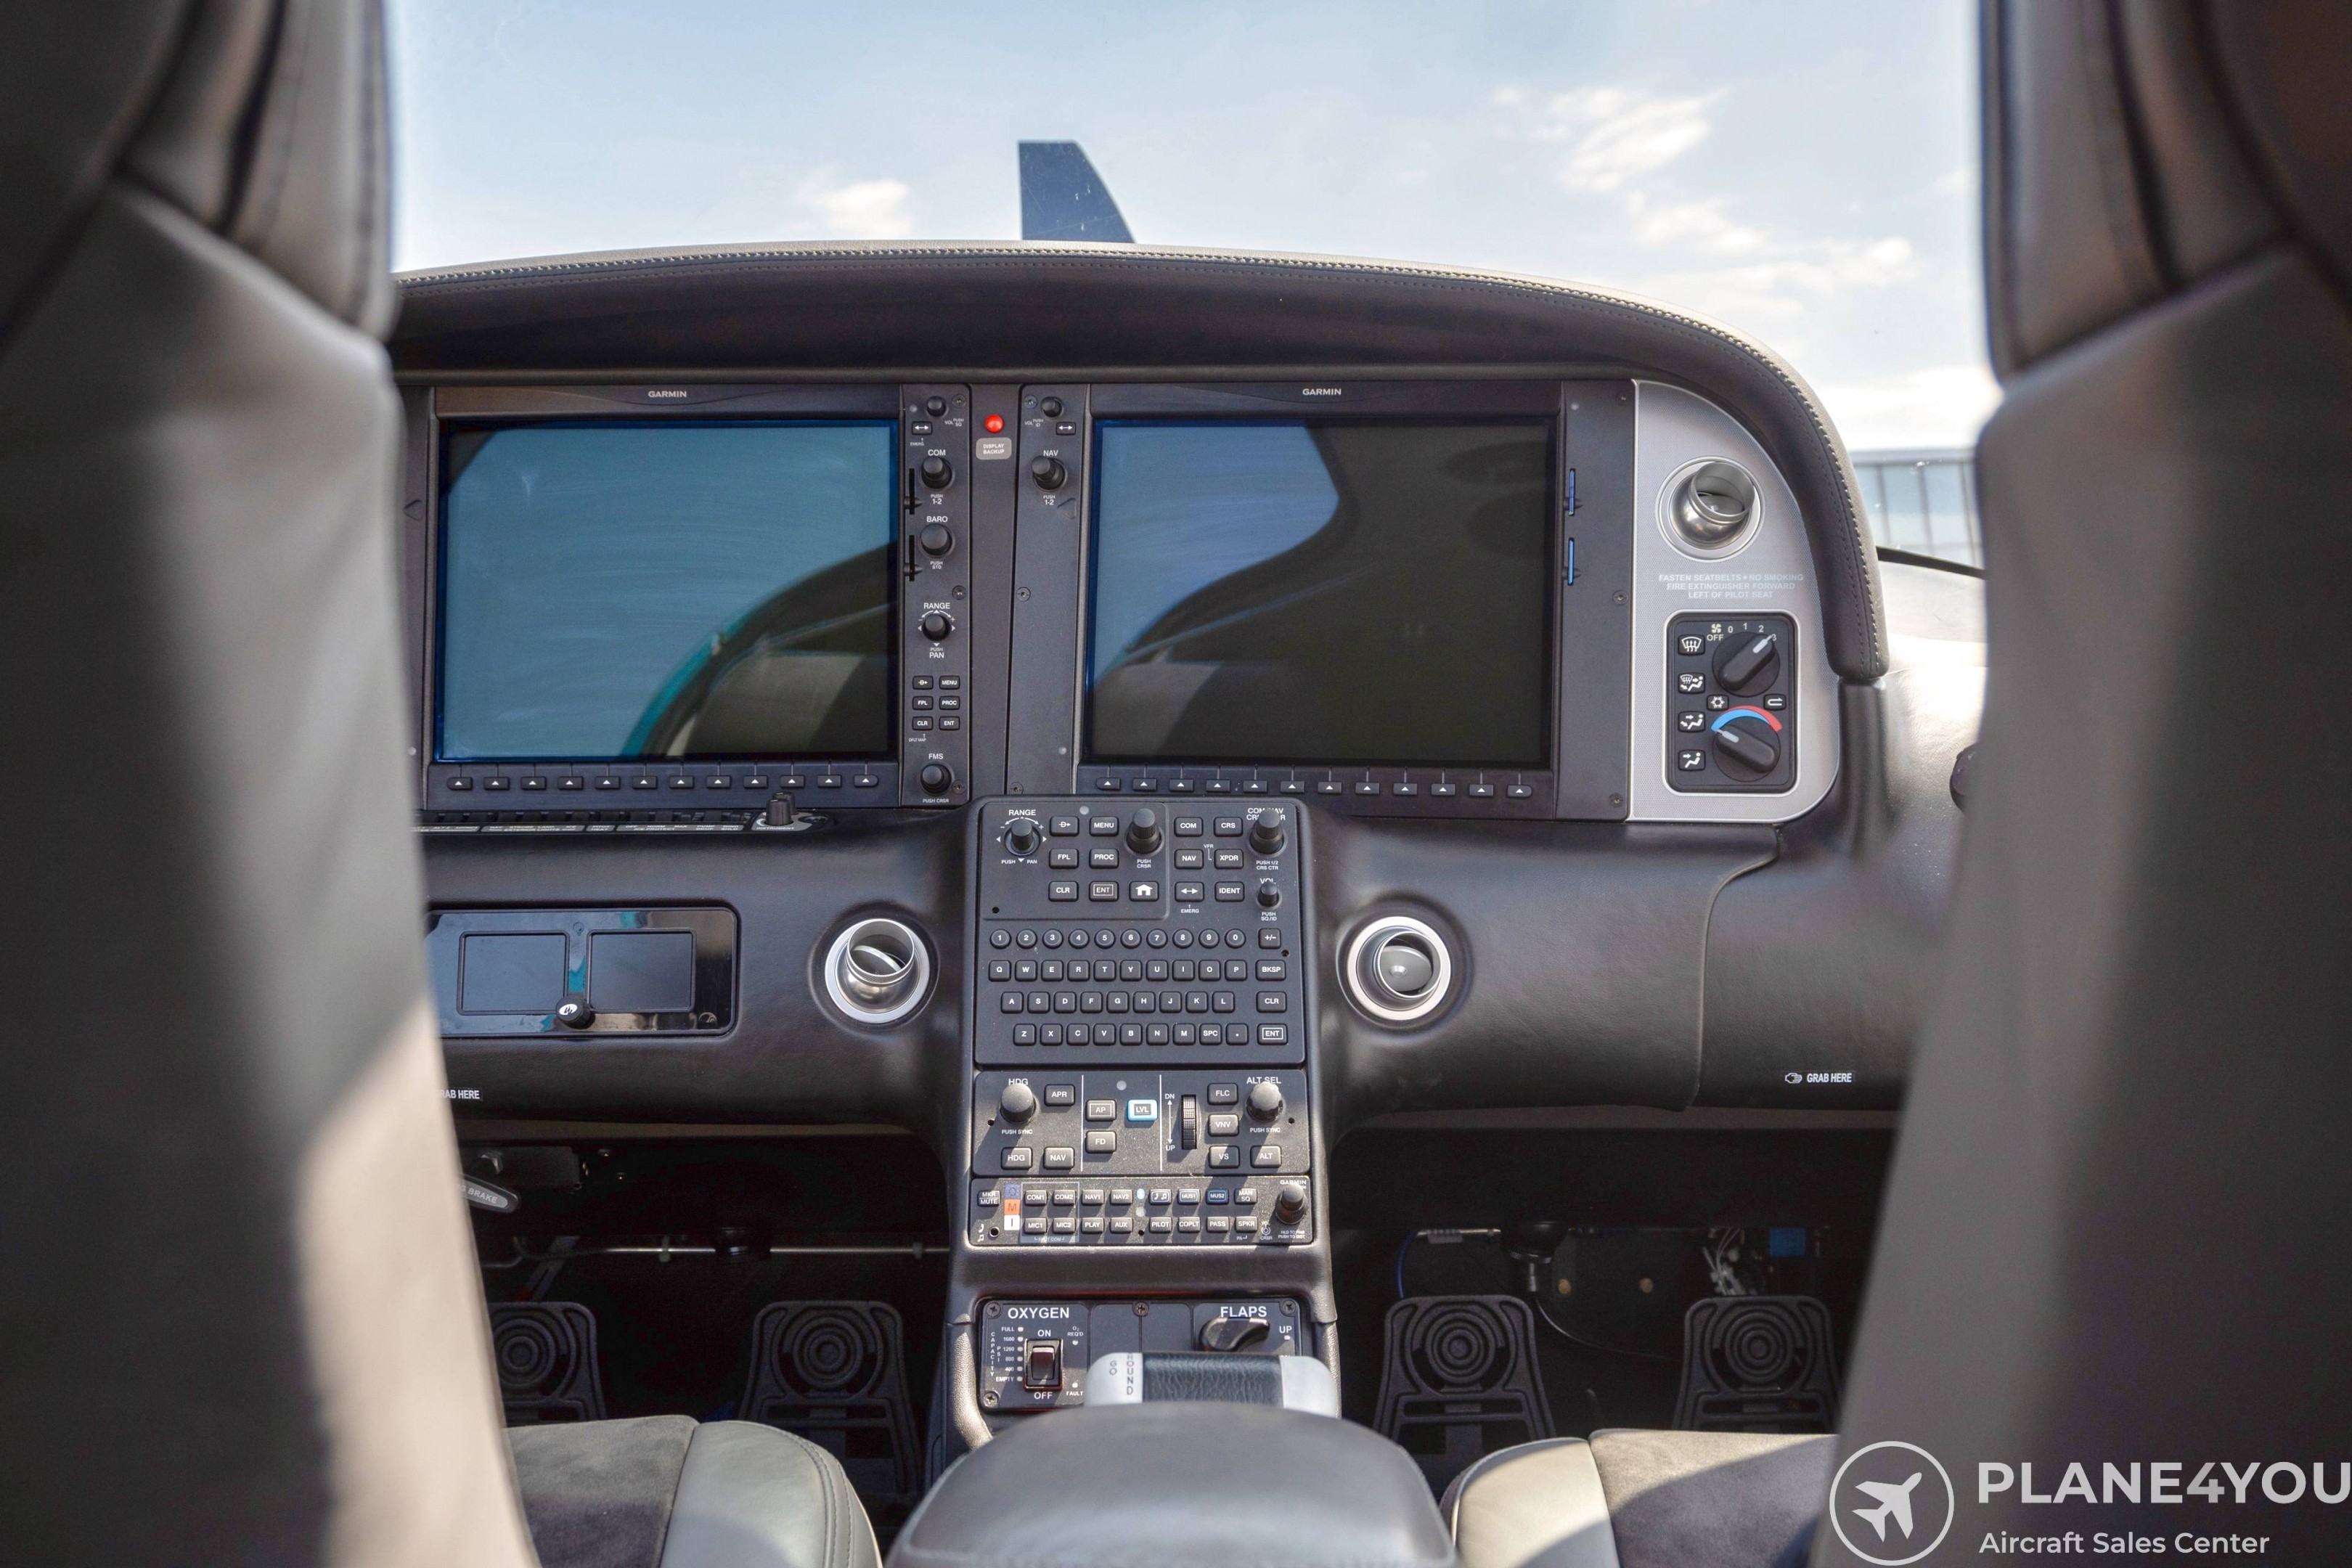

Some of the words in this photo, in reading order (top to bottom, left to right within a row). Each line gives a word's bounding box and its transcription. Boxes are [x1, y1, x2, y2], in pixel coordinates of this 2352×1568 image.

[1807, 1073, 1829, 1082] GRAB
[1830, 1073, 1852, 1082] HERE
[457, 1090, 480, 1099] HERE
[468, 1188, 497, 1204] BRAKE
[1008, 1307, 1069, 1318] OXYGEN
[1220, 1306, 1267, 1318] FLAPS
